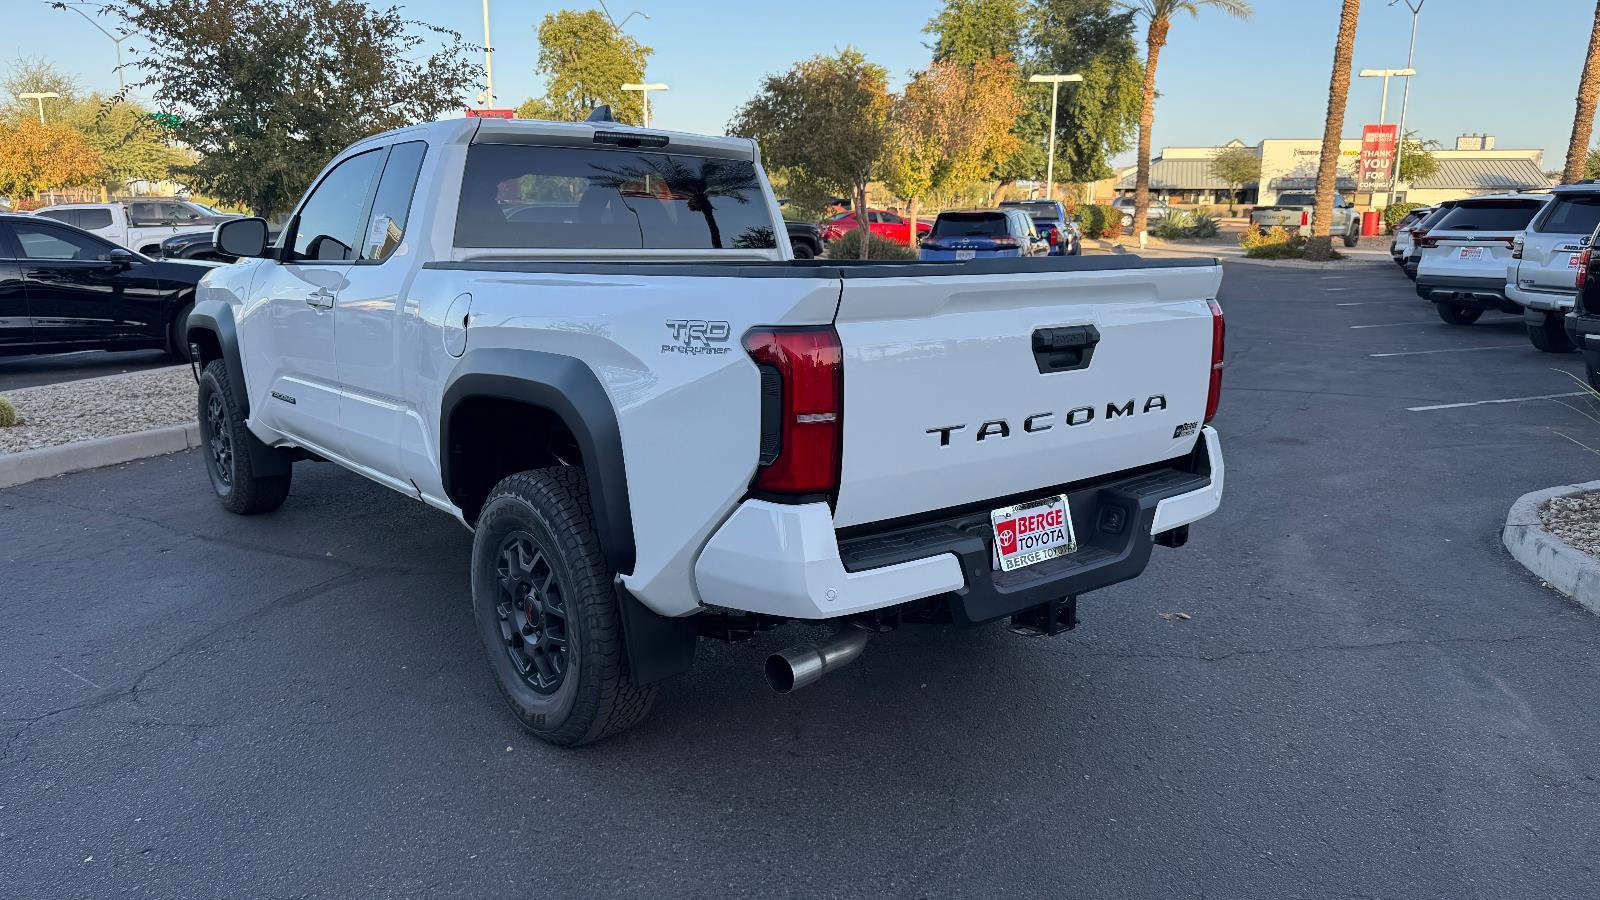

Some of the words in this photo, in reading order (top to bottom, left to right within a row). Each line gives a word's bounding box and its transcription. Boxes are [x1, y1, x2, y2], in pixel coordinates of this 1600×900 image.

[1363, 150, 1392, 158] THANK
[1363, 159, 1390, 169] YOU
[1365, 172, 1385, 180] FOR
[665, 319, 732, 347] TRD
[925, 393, 1168, 447] TACOMA
[1017, 508, 1063, 535] BERGE
[1018, 528, 1065, 551] TOYOTA
[1005, 551, 1042, 570] BERGE
[1042, 543, 1074, 558] TOYOTA
